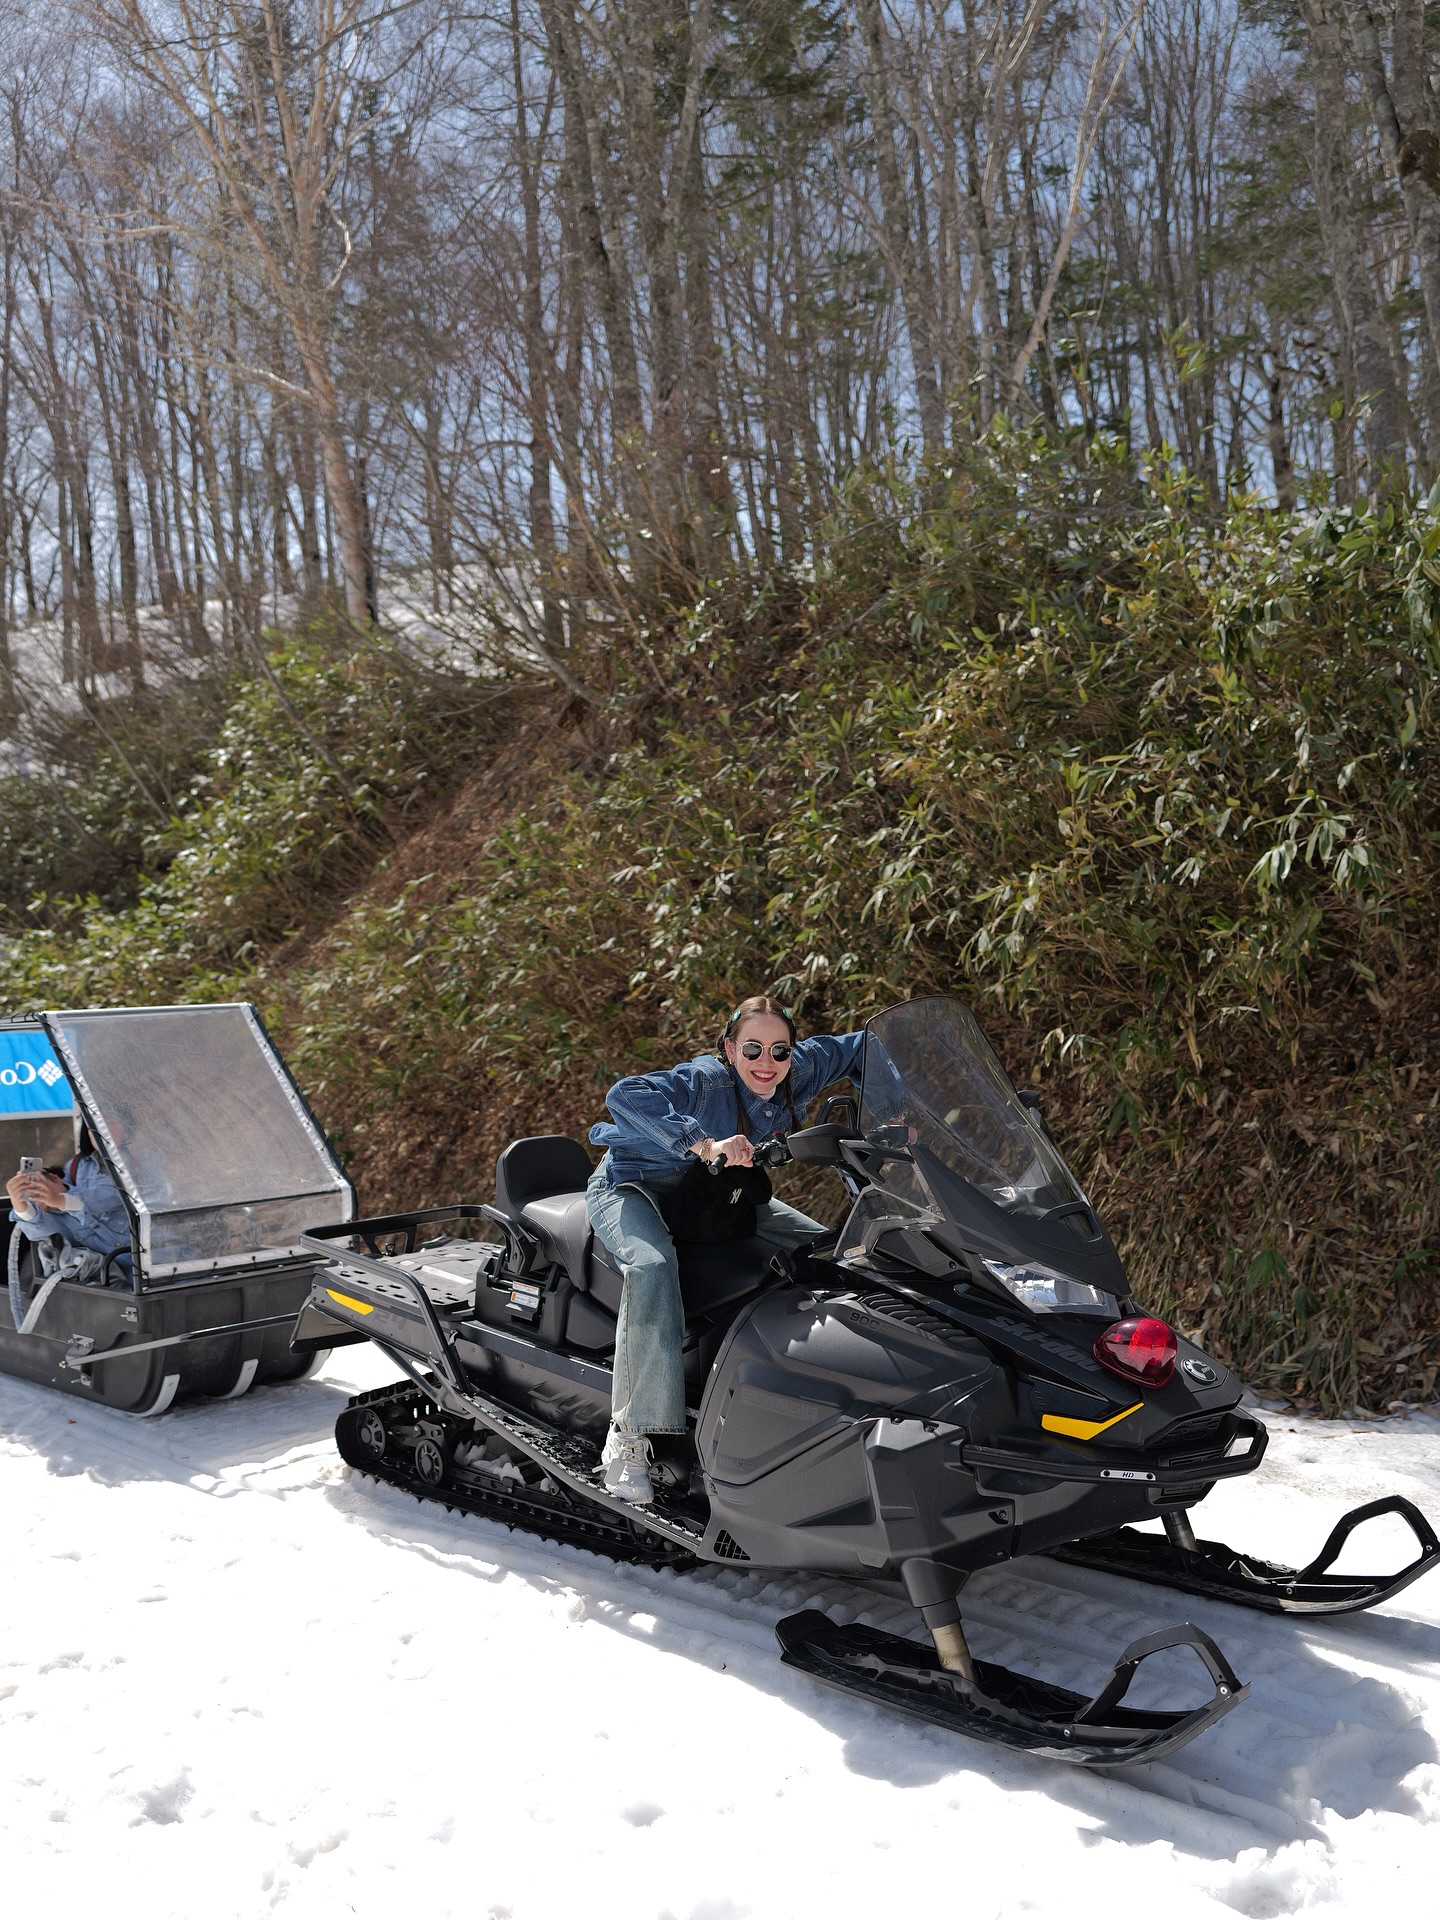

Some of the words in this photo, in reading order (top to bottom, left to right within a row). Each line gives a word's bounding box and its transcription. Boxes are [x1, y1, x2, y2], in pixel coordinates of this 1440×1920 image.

[374, 1309, 408, 1330] 24
[850, 1312, 880, 1330] 900
[1122, 1471, 1135, 1479] HD
